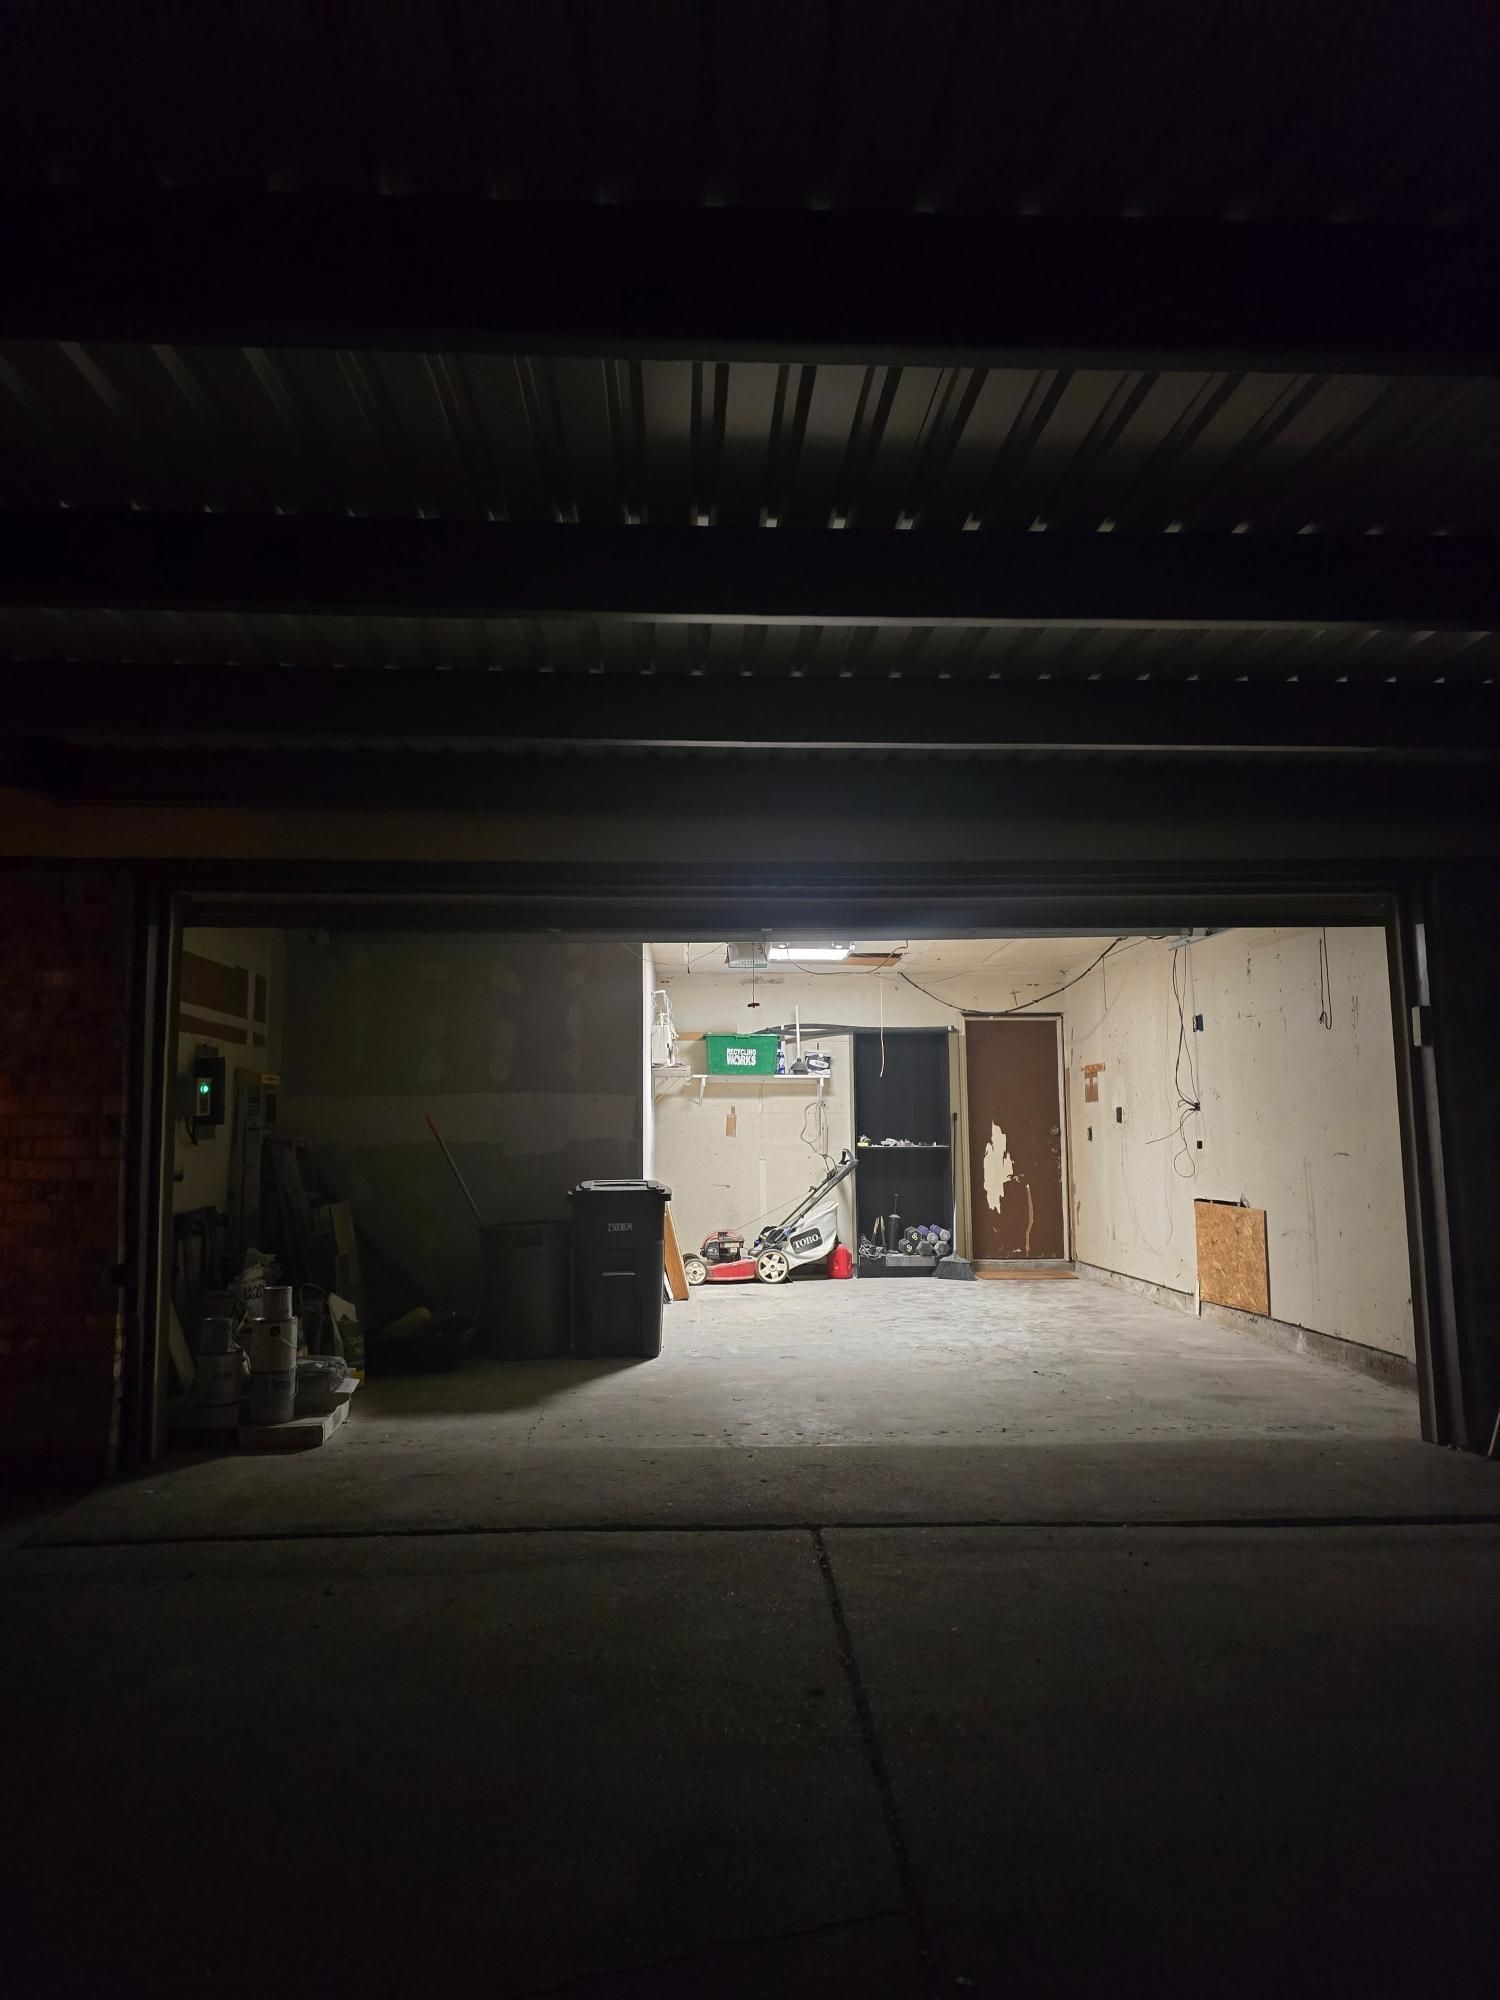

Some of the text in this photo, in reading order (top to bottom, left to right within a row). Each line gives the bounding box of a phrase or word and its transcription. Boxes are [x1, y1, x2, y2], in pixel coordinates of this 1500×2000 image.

[727, 1048, 756, 1056] RECYCLING
[727, 1055, 756, 1066] WORKS
[794, 1234, 819, 1248] TORO
